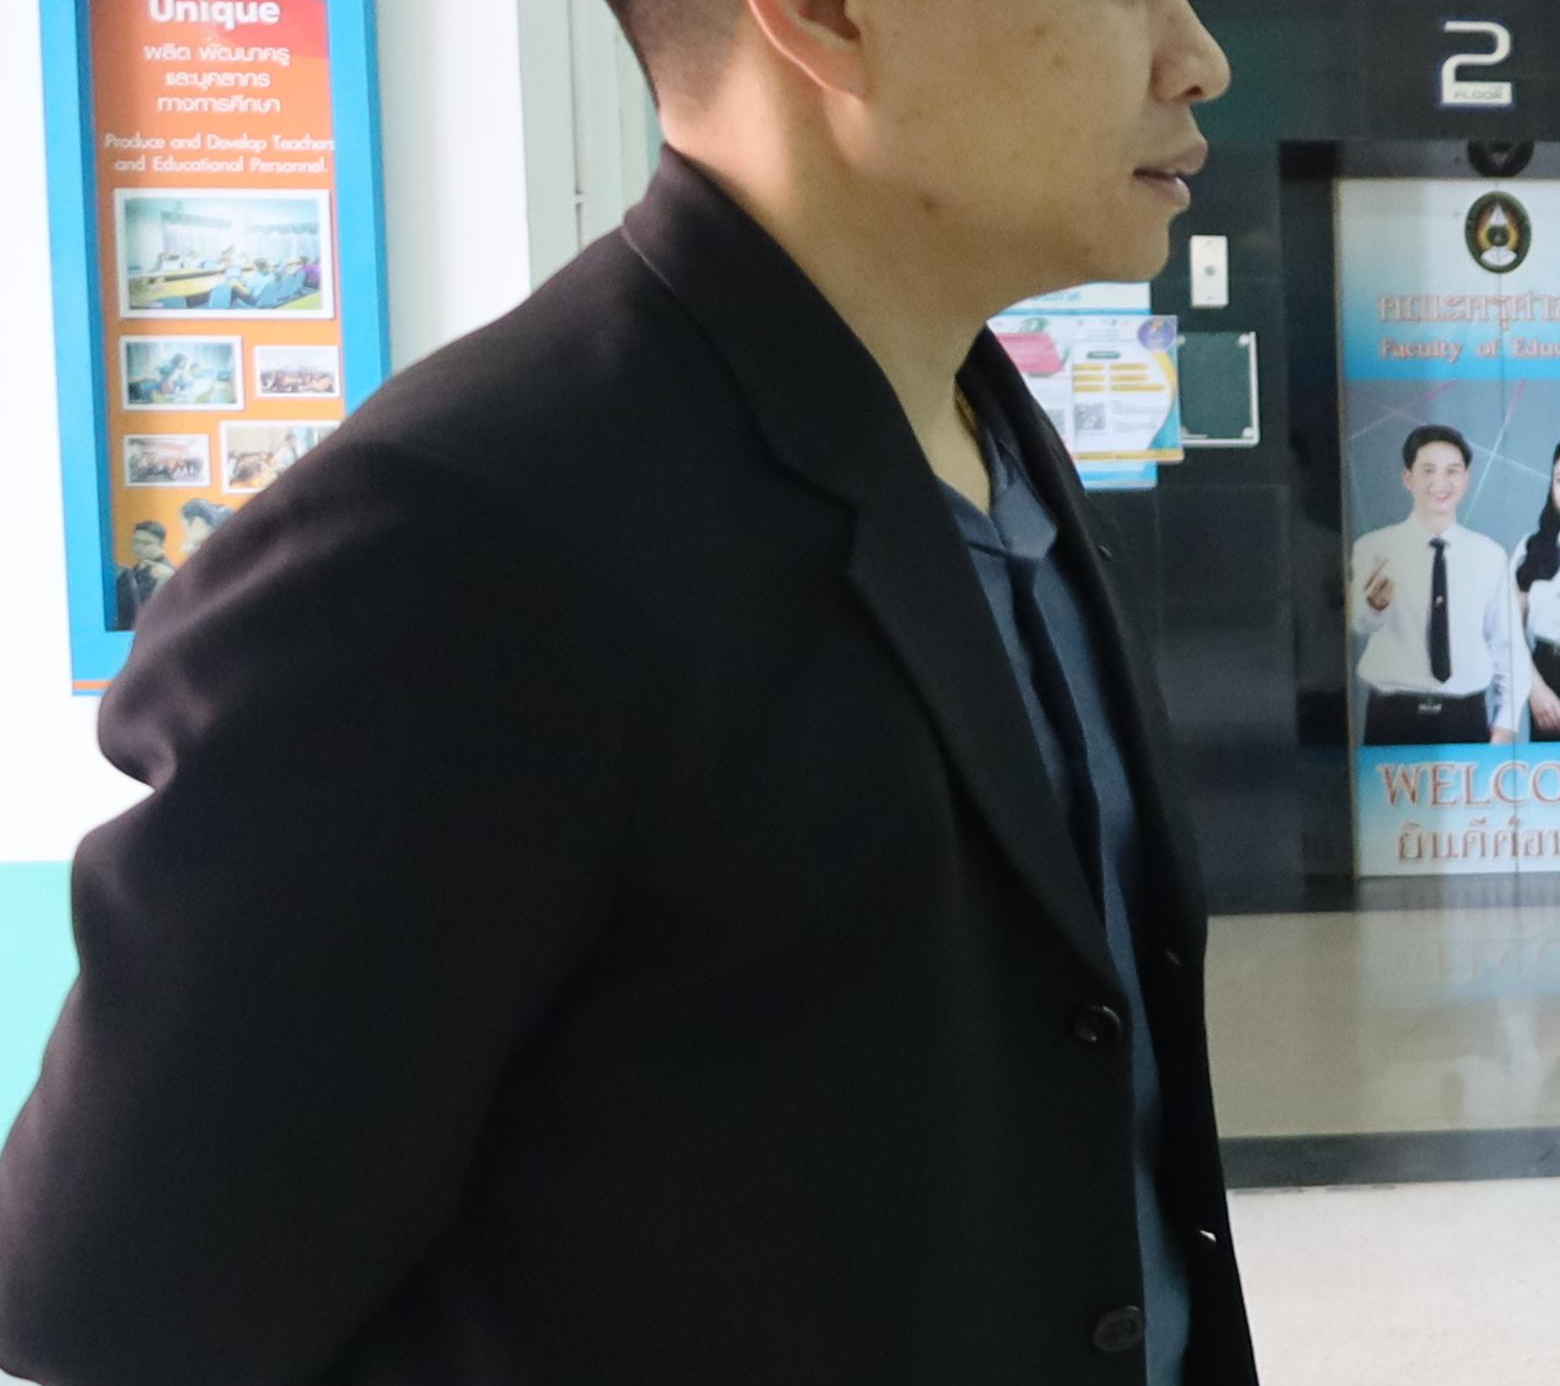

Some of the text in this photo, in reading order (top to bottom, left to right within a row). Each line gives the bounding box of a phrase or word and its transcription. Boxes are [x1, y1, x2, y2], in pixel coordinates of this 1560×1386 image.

[1441, 20, 1513, 105] 2
[104, 131, 336, 153] Produce and Develop Teachers
[114, 155, 146, 172] and
[153, 155, 244, 173] Educational
[1379, 337, 1464, 364] Faculty
[1475, 336, 1501, 359] of
